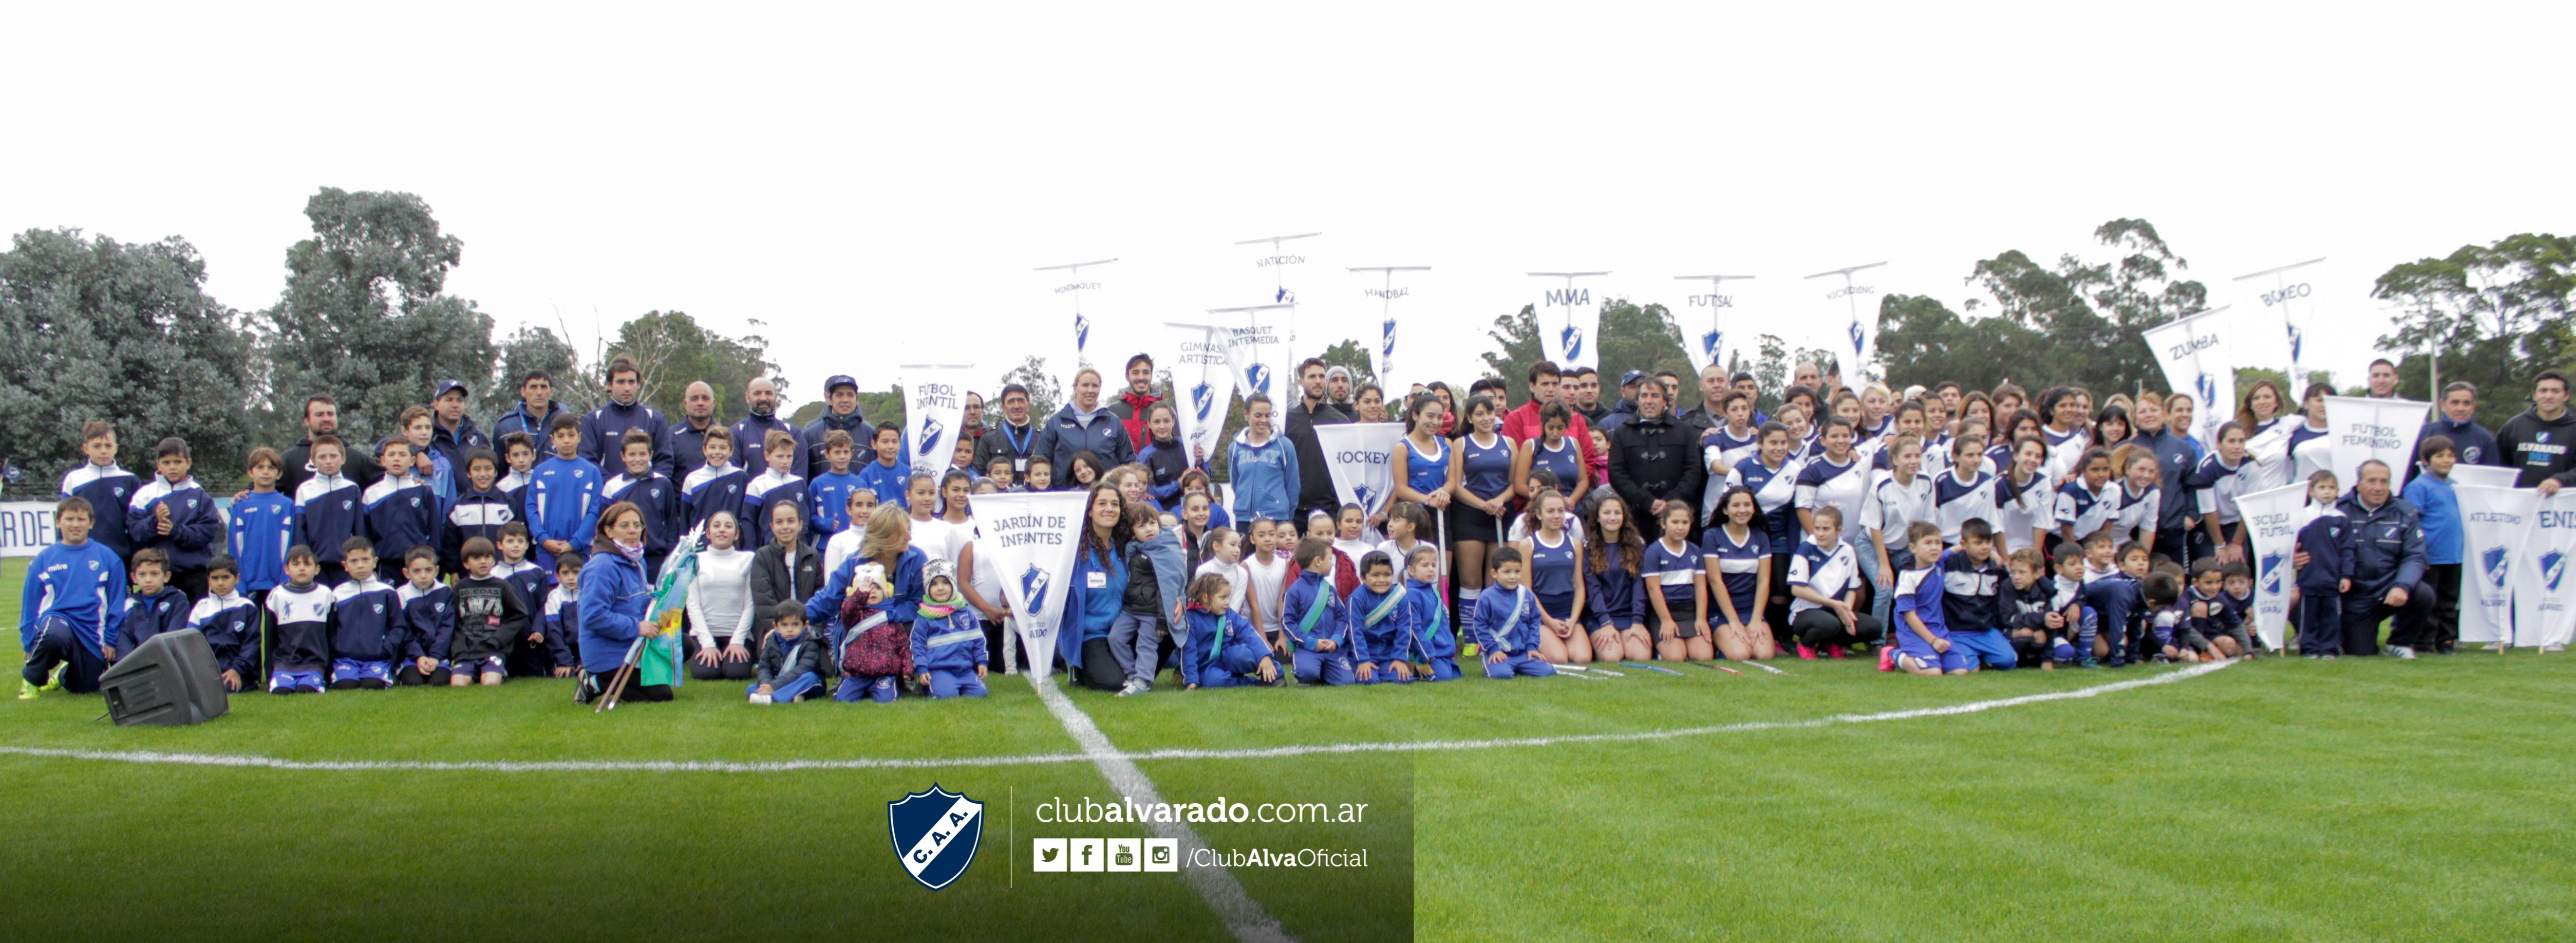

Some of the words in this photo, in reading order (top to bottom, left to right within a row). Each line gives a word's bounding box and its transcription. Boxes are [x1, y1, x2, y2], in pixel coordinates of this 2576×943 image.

[1546, 288, 1590, 307] MMA
[1688, 294, 1733, 307] FUTSAL
[1233, 326, 1273, 337] BASQUET
[1180, 342, 1221, 353] GIMNAS
[1228, 336, 1279, 347] INTERMEDIA
[0, 511, 17, 547] R
[994, 514, 1043, 532] JARDÍN
[1048, 516, 1066, 528] DE
[1001, 532, 1063, 548] INFANTES
[48, 563, 67, 572] mitre
